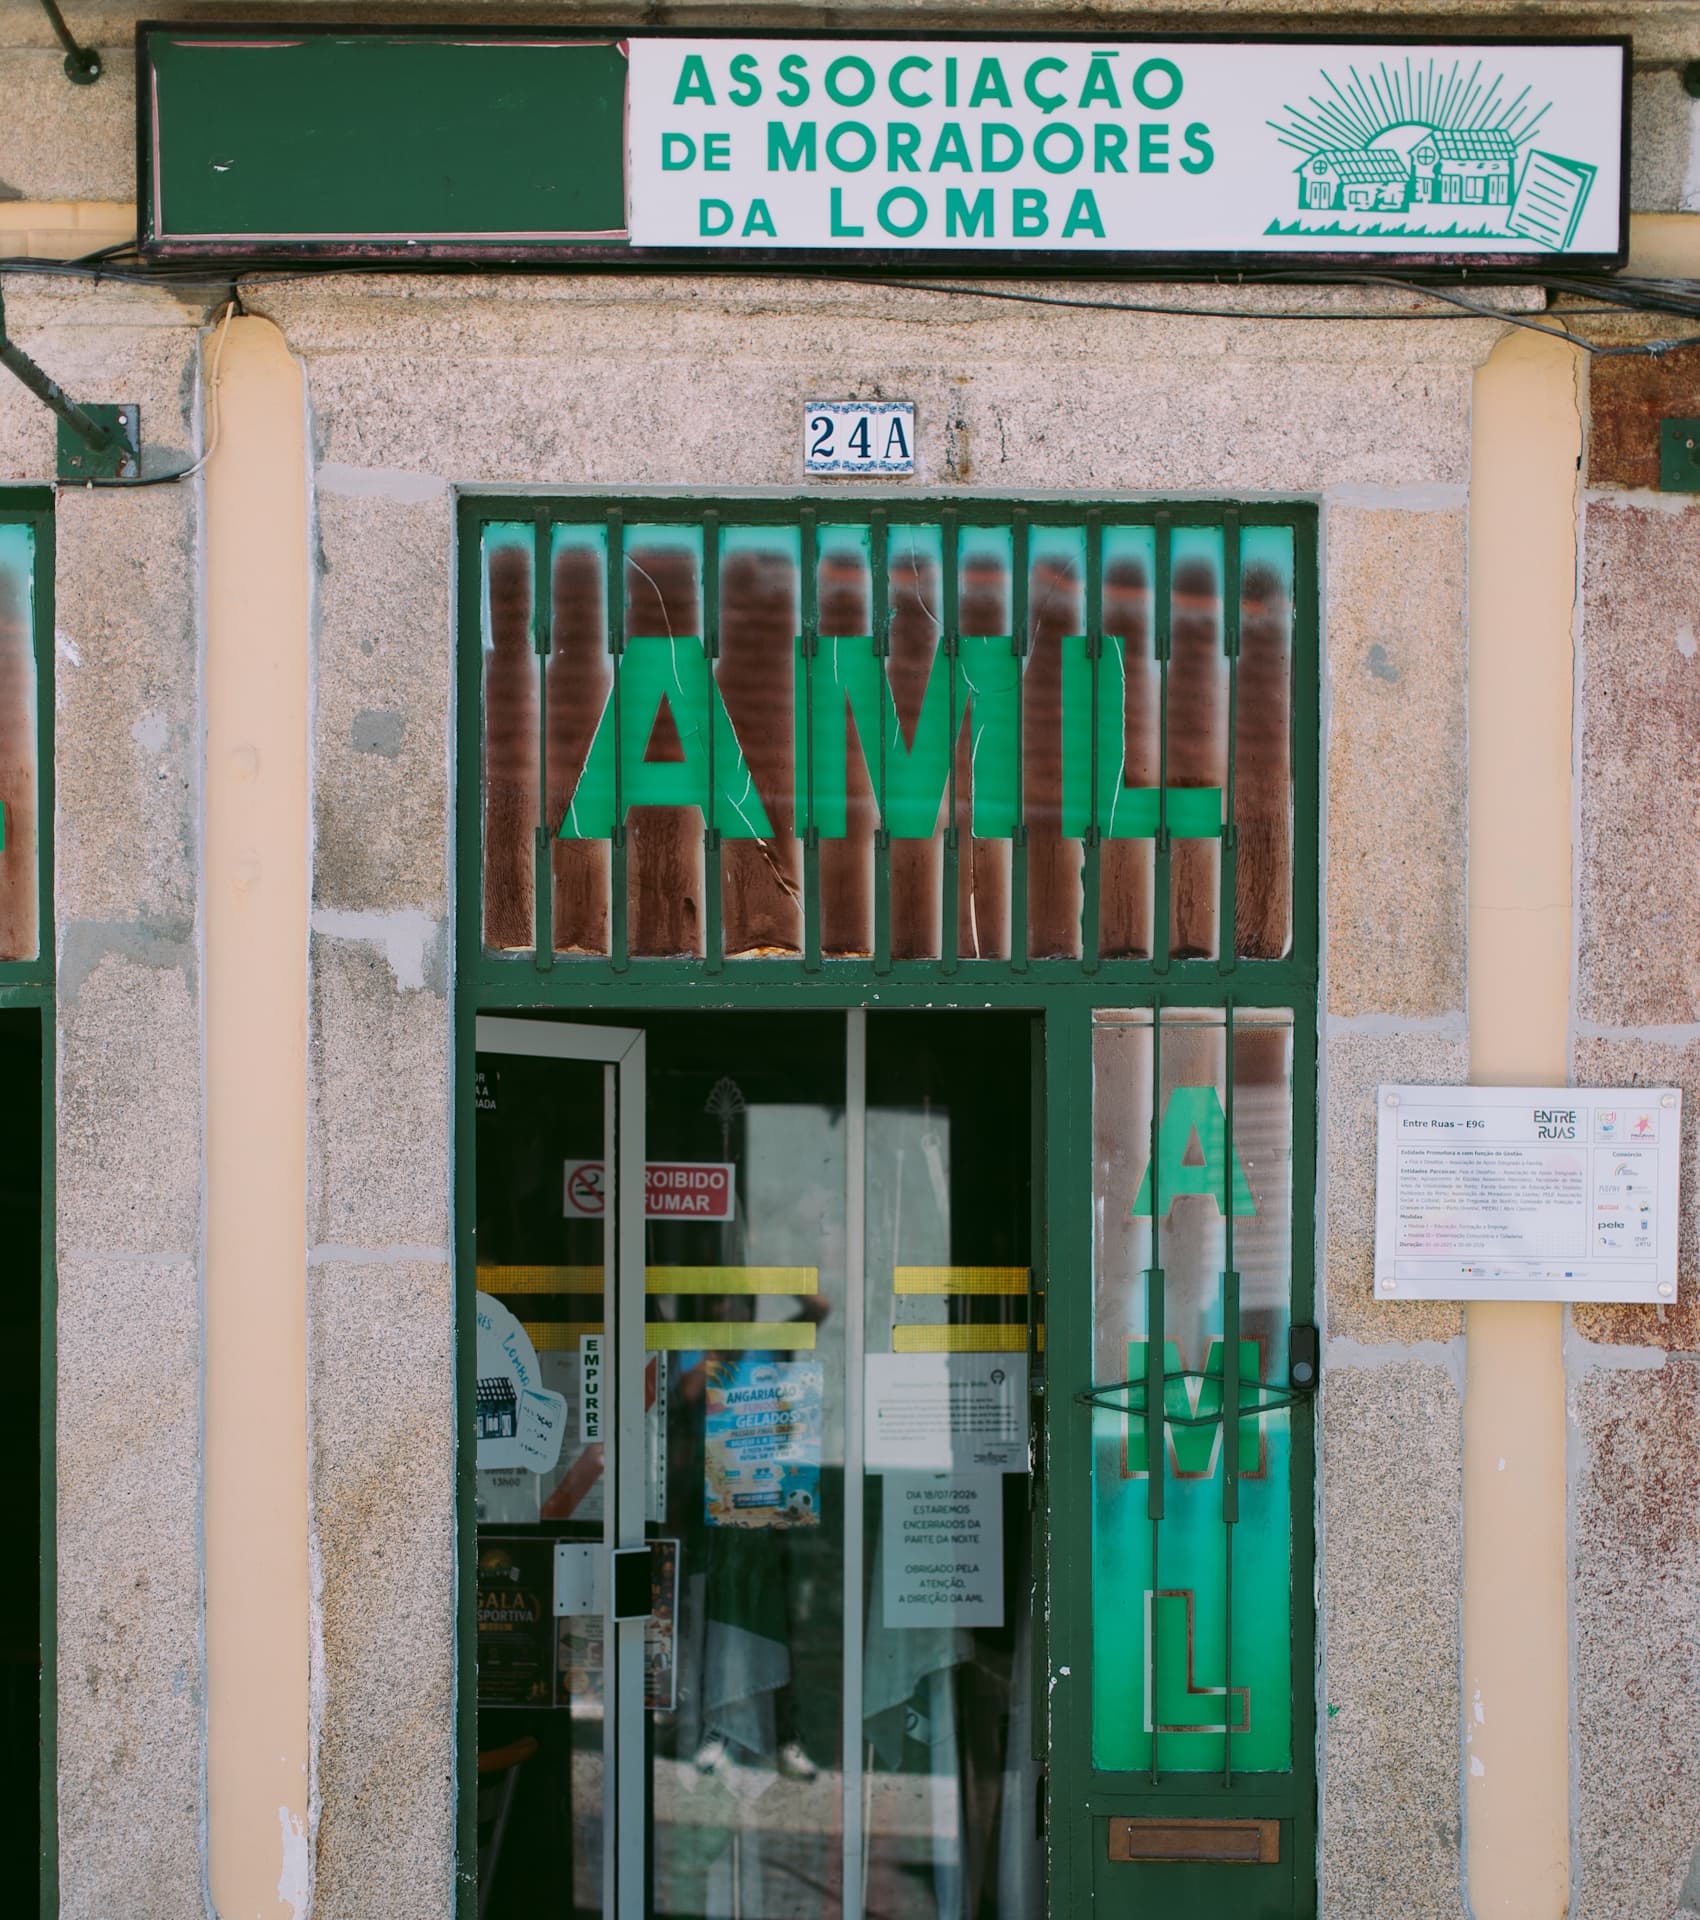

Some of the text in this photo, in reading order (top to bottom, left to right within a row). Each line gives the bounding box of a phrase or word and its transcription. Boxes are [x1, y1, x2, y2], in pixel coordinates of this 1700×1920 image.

[673, 51, 1184, 114] ASSOCIAÇÃO
[662, 121, 1215, 175] DE MORADORES
[700, 186, 1106, 238] DA LOMBA
[811, 416, 910, 458] 24A
[558, 635, 1222, 839] AML
[1533, 1110, 1577, 1123] ENTRE
[1403, 1119, 1428, 1128] Entre
[1431, 1120, 1455, 1129] Ruas
[1466, 1120, 1485, 1129] E9G
[1538, 1126, 1576, 1139] RUAS
[646, 1171, 725, 1190] ROIBIDO
[584, 1340, 600, 1437] EMPURRE
[906, 1491, 922, 1500] DIA
[913, 1505, 970, 1515] ESTAREMOS
[903, 1520, 981, 1530] ENCERRADOS DA
[904, 1535, 980, 1544] PARTE DA NOITE
[905, 1564, 980, 1574] OBRIGADO PELA
[950, 1594, 963, 1603] DA
